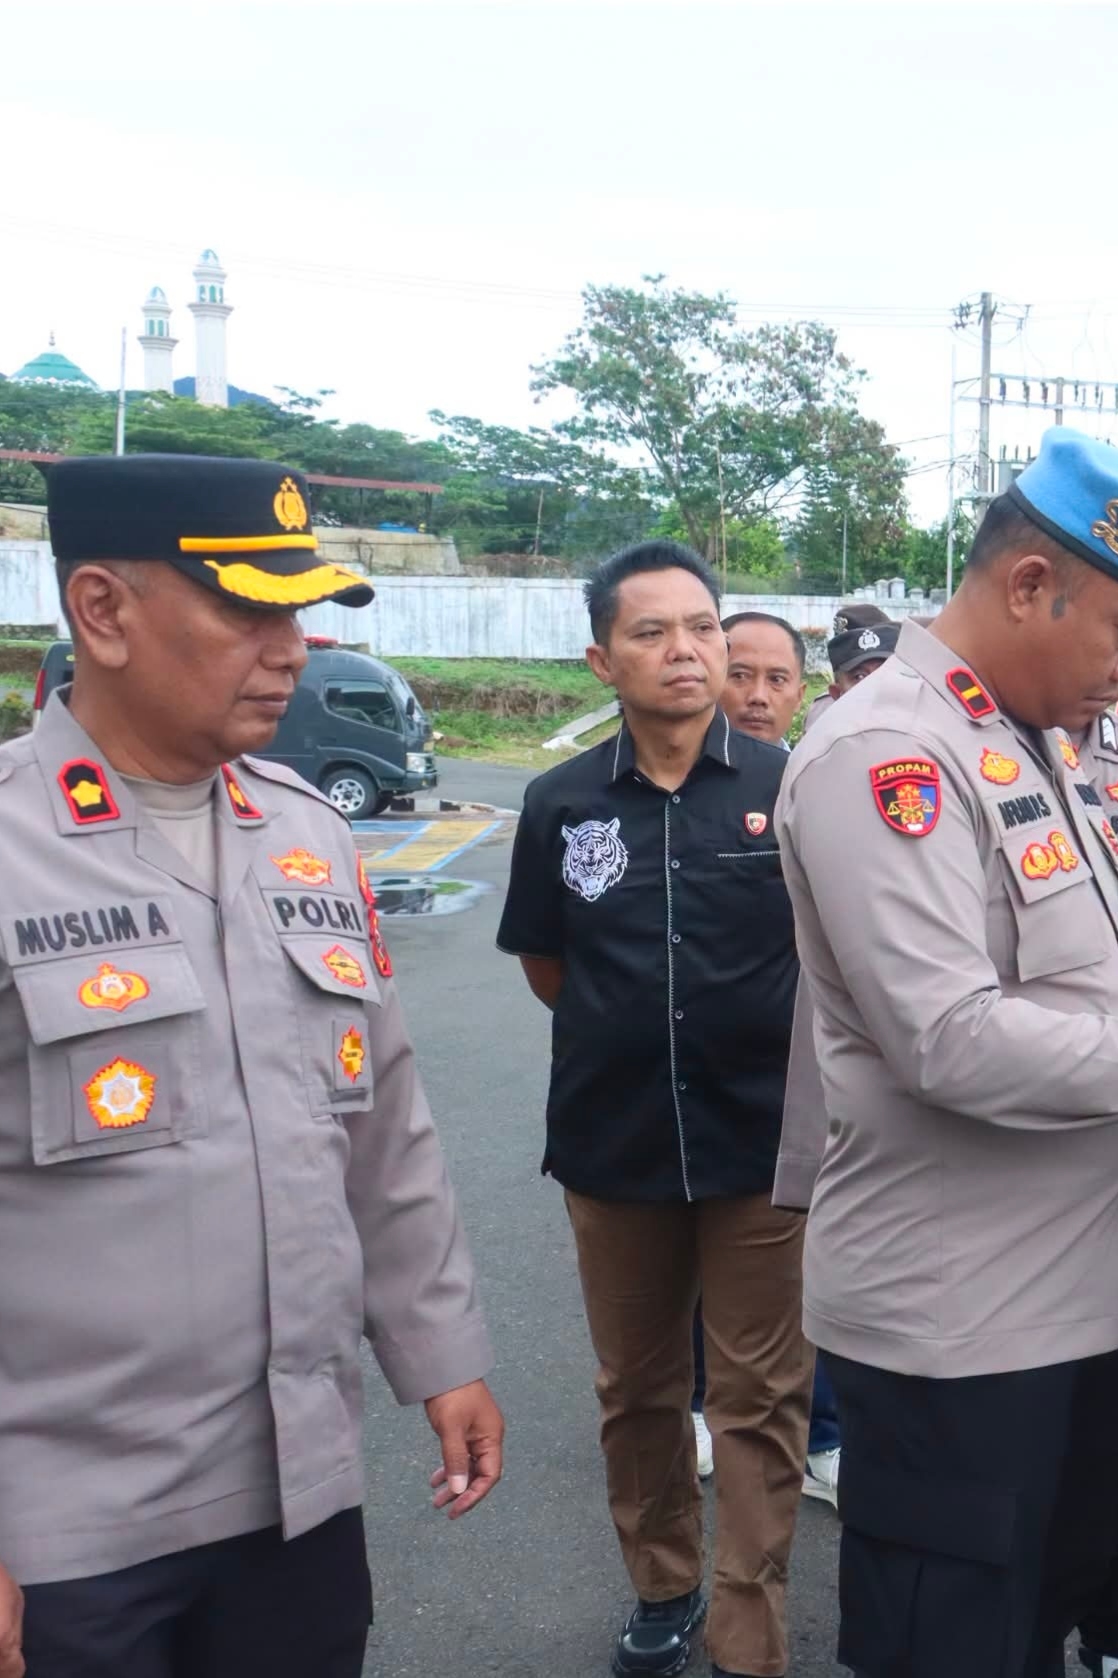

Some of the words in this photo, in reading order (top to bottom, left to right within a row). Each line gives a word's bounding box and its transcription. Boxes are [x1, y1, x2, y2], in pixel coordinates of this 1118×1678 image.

[878, 763, 931, 778] PROPAM
[15, 905, 140, 956] MUSLIM
[147, 902, 170, 937] A
[273, 896, 363, 932] POLRI
